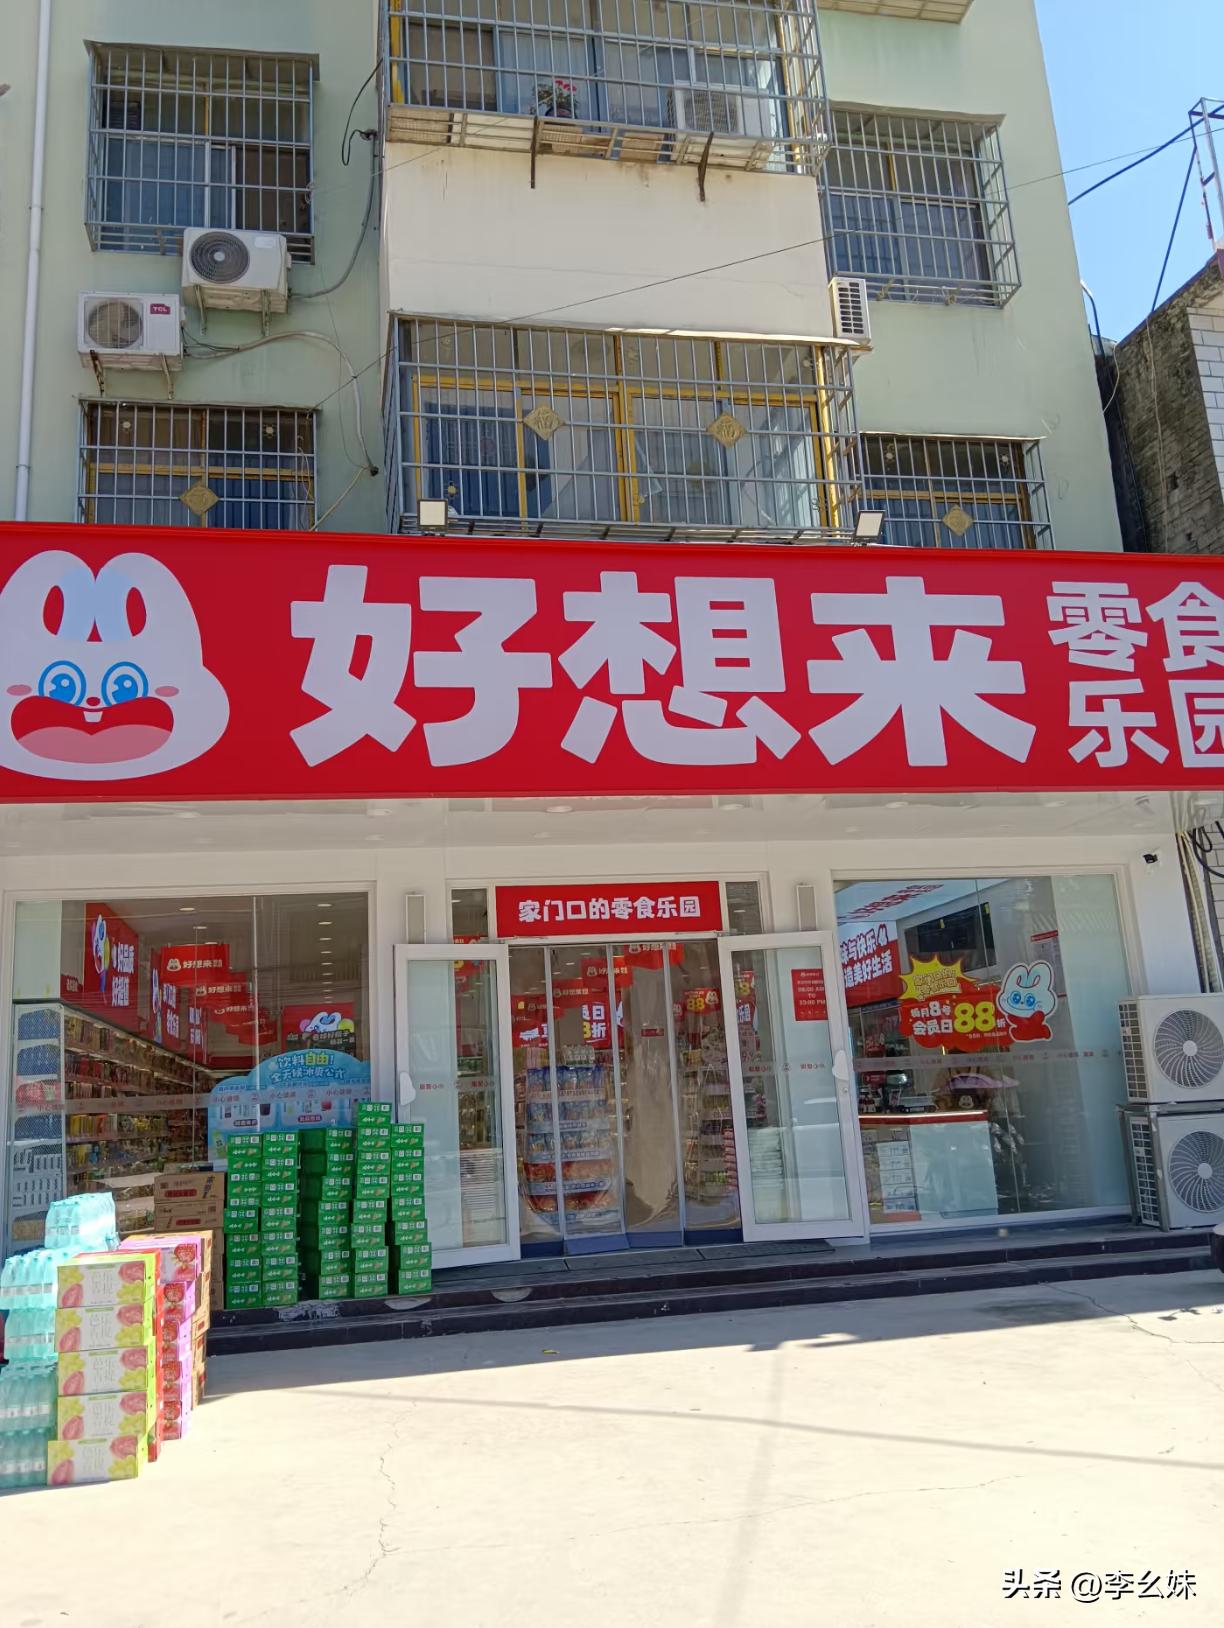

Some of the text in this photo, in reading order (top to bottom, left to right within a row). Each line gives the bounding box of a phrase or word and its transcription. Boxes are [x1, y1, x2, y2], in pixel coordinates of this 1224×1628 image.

[290, 564, 1037, 768] 好想来
[1046, 581, 1224, 672] 零食
[1068, 678, 1224, 768] 乐园
[518, 896, 700, 923] 家门口的零食乐园
[912, 1019, 953, 1035] 会员日
